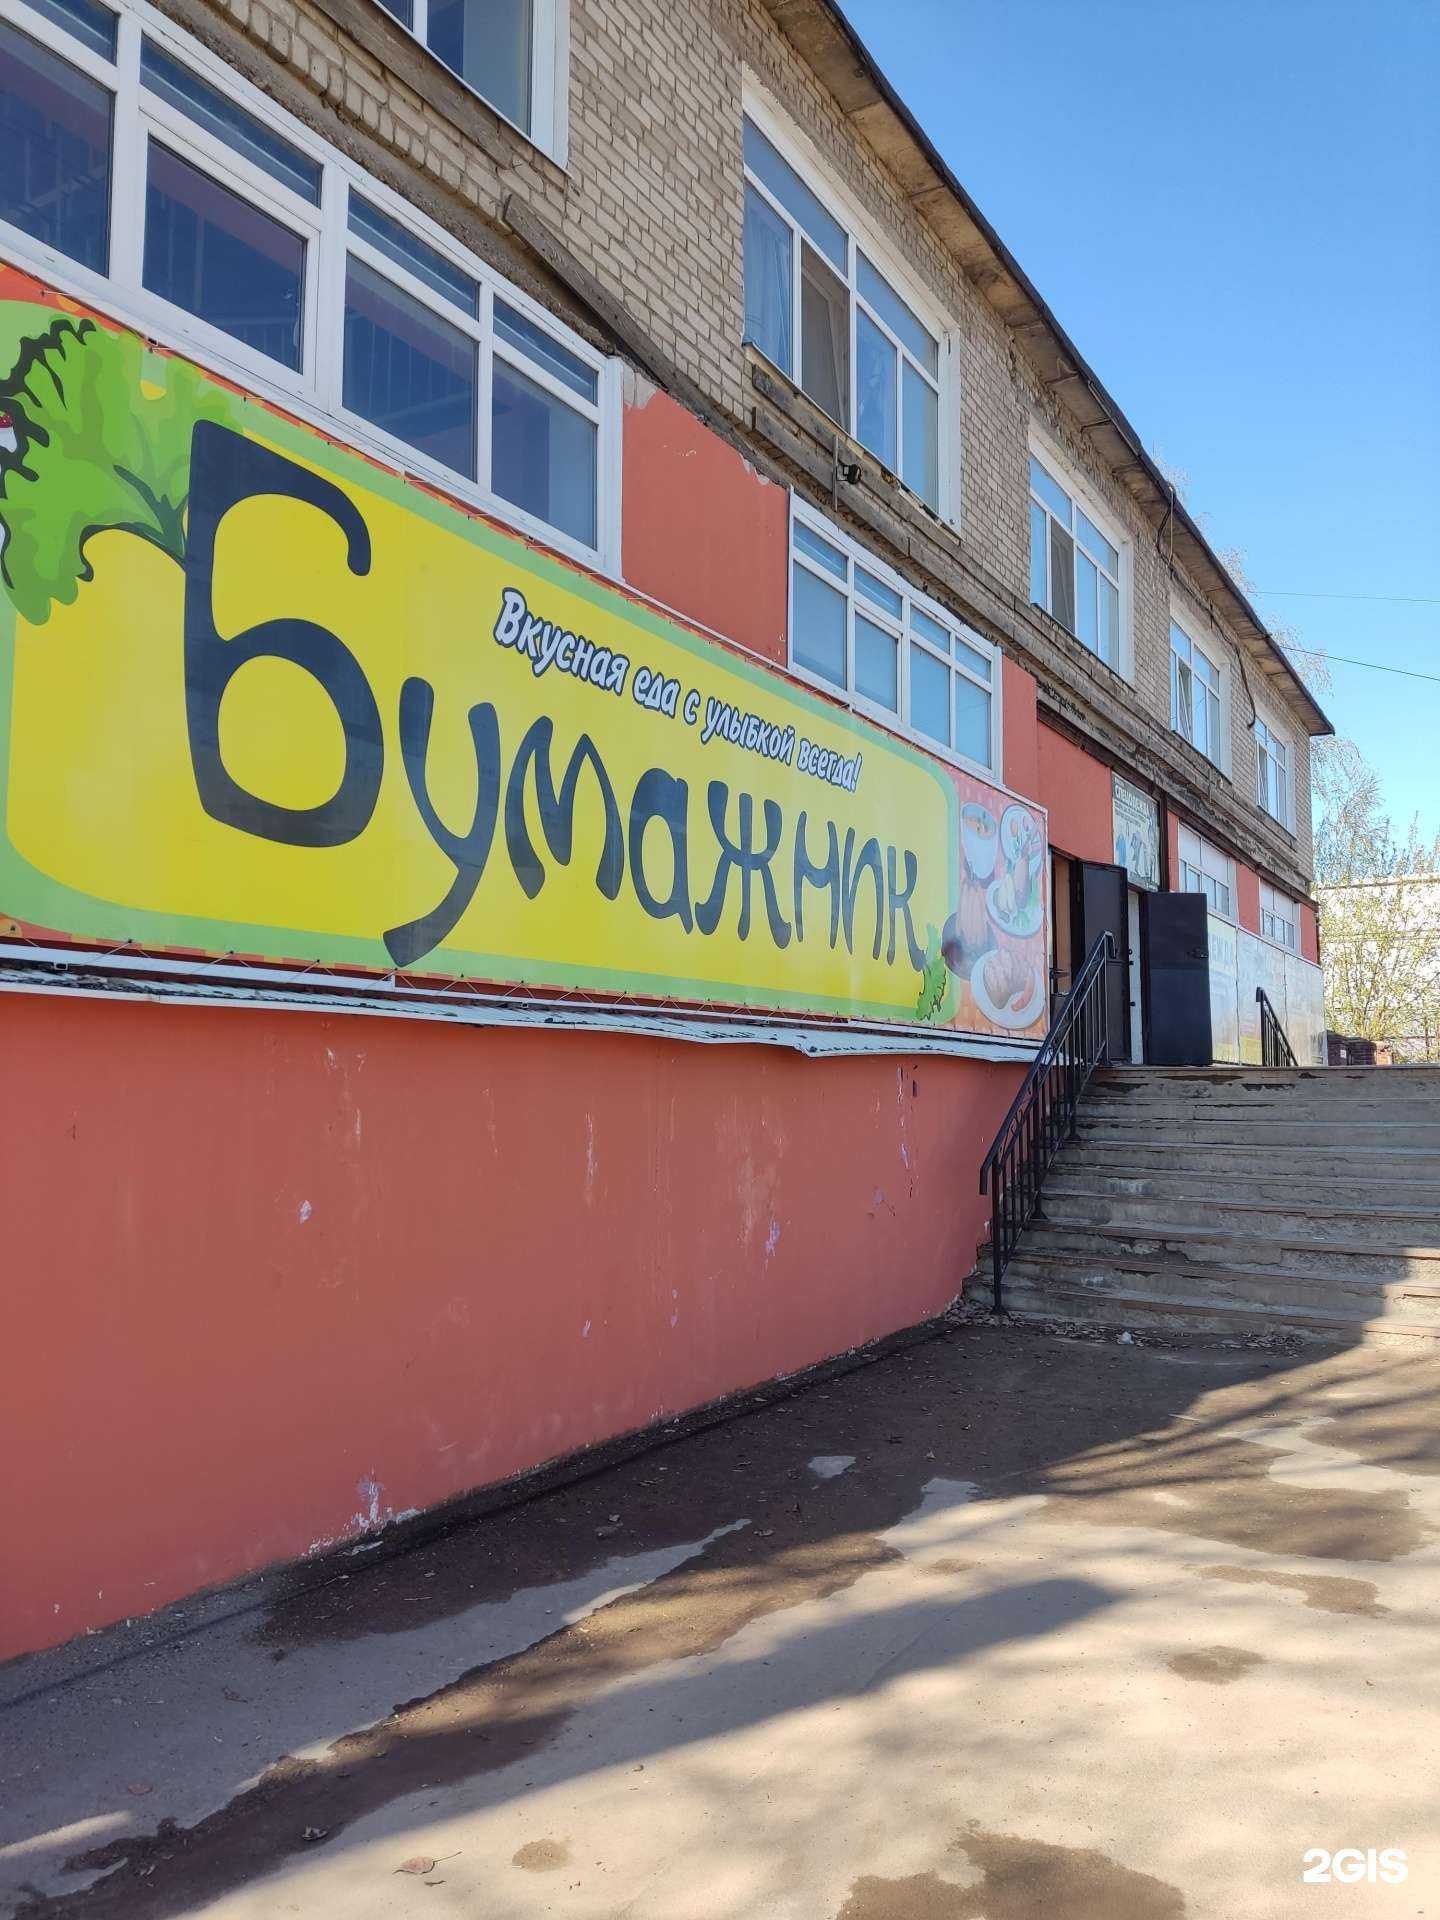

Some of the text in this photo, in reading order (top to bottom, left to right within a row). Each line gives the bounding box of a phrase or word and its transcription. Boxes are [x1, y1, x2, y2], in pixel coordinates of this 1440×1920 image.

[184, 420, 928, 973] Бумажник
[493, 587, 863, 793] Вкусная еда с улыбкой всегда!
